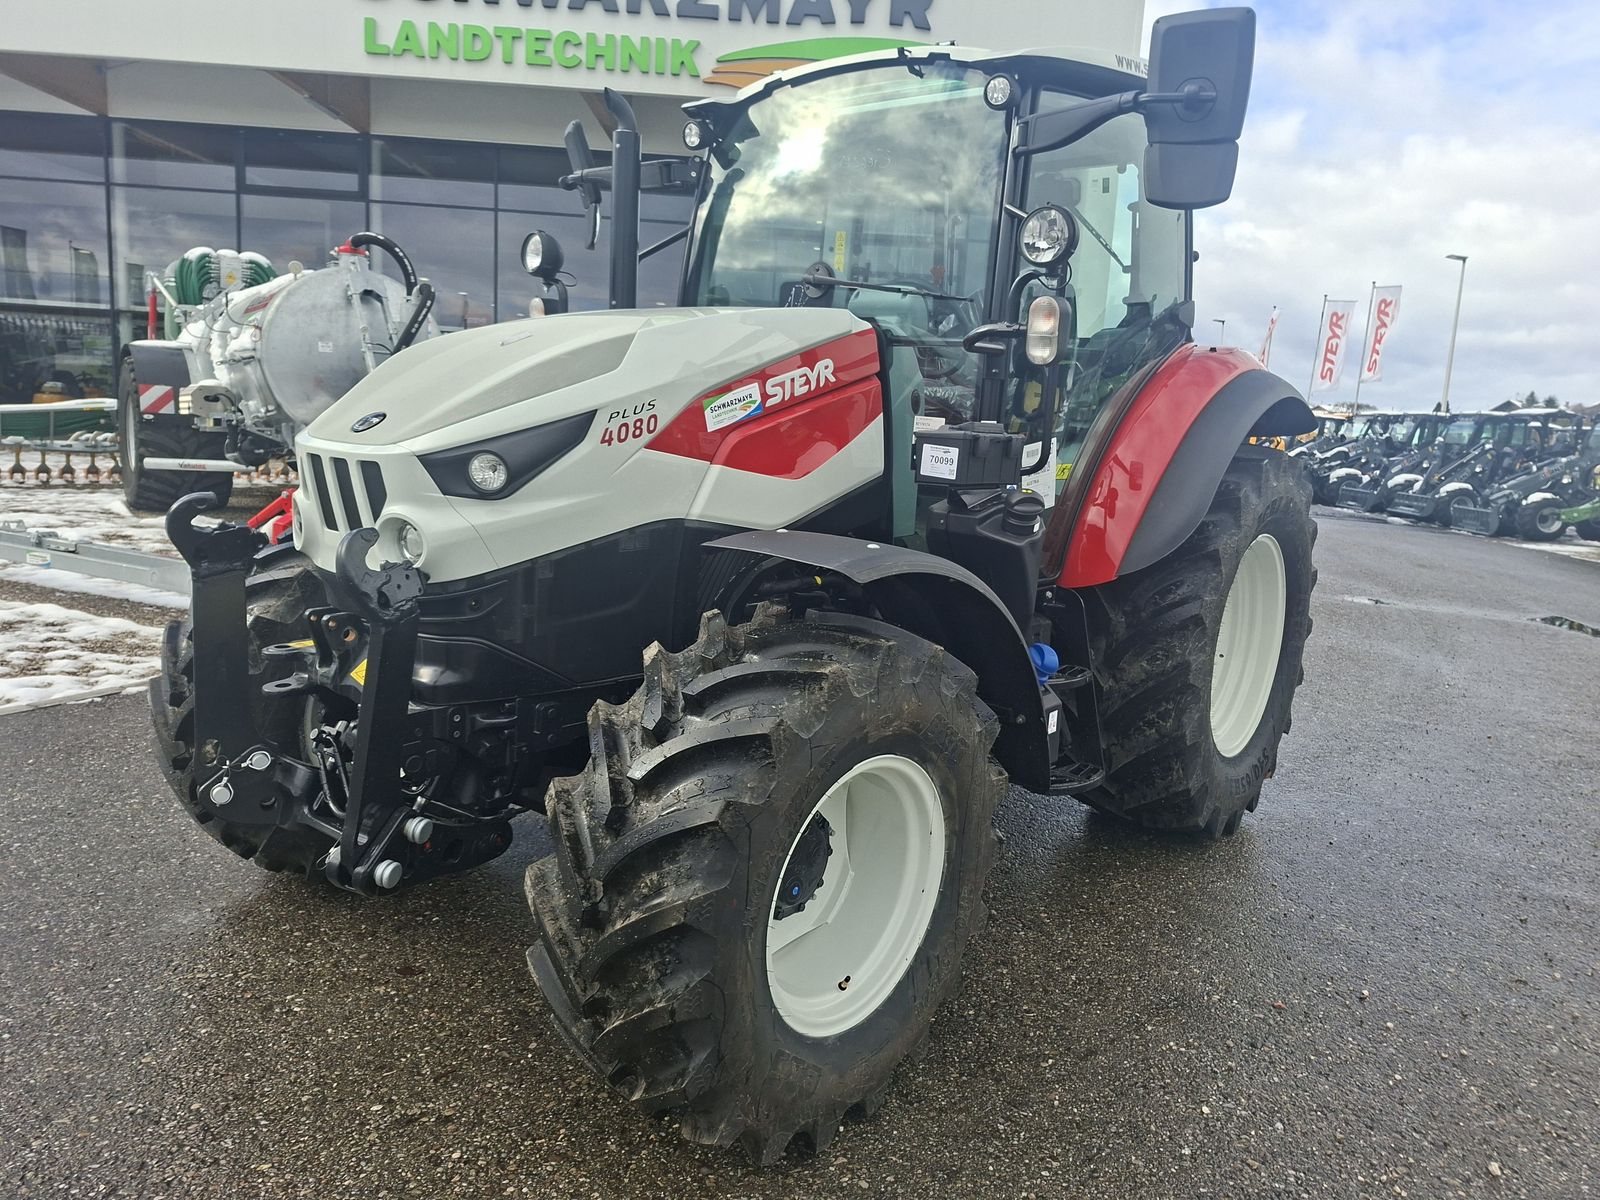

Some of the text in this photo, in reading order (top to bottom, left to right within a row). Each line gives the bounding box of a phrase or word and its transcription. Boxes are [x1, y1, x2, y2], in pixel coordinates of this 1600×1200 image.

[364, 17, 700, 77] LANDTECHNIK
[1320, 311, 1345, 383] STEYR
[1367, 298, 1393, 374] STEYR
[765, 358, 836, 407] STEYR
[607, 399, 657, 423] PLUS
[710, 393, 753, 414] SCHWARZMAYR
[600, 413, 658, 447] 4080
[930, 455, 954, 466] 70099
